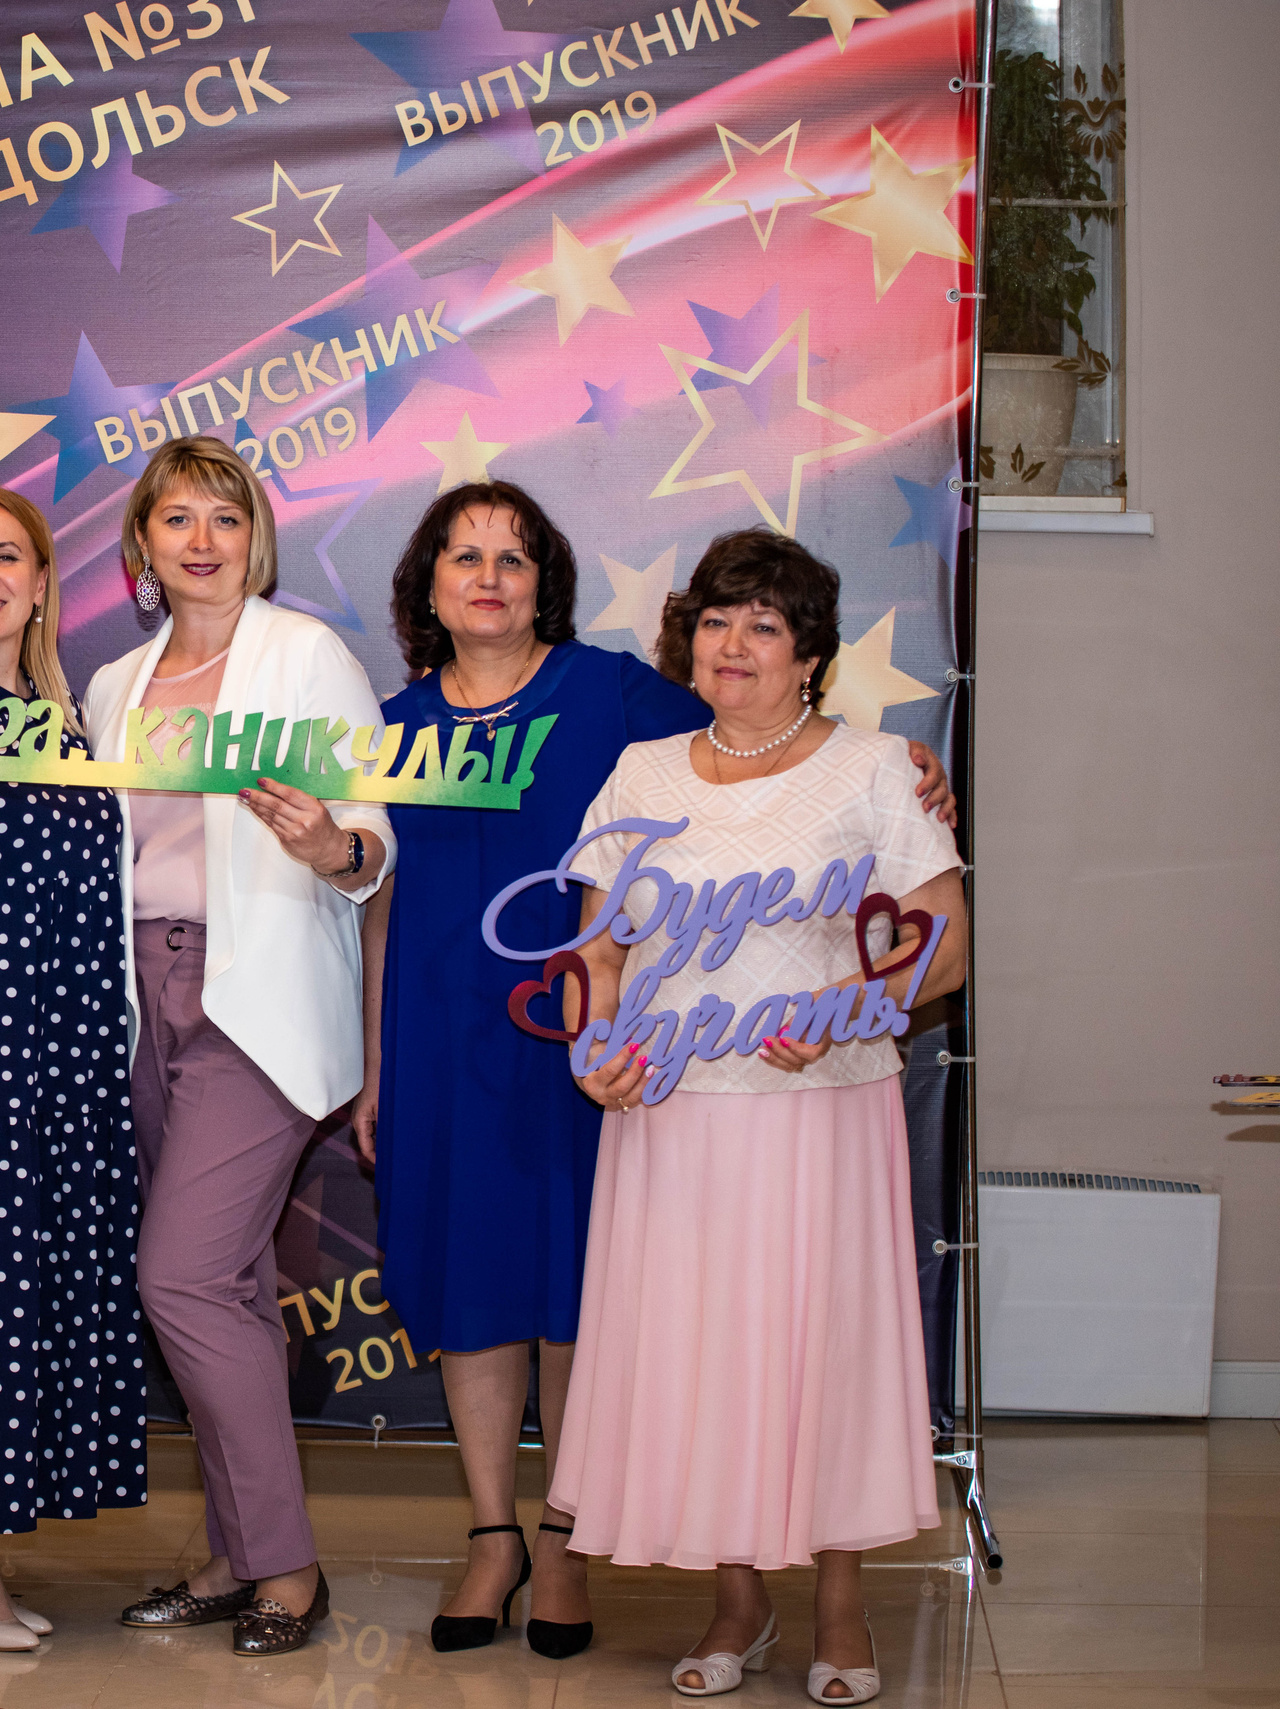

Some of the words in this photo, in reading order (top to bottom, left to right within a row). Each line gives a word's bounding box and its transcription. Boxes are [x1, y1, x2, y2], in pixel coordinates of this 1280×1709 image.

[394, 0, 761, 146] ВЫПУСКНИК
[535, 90, 658, 167] 2019
[94, 299, 462, 464] ВЫПУСКНИК
[235, 407, 357, 480] 2019
[481, 816, 876, 976] Будем
[570, 914, 948, 1105] скучать!
[325, 1328, 441, 1394] 201
